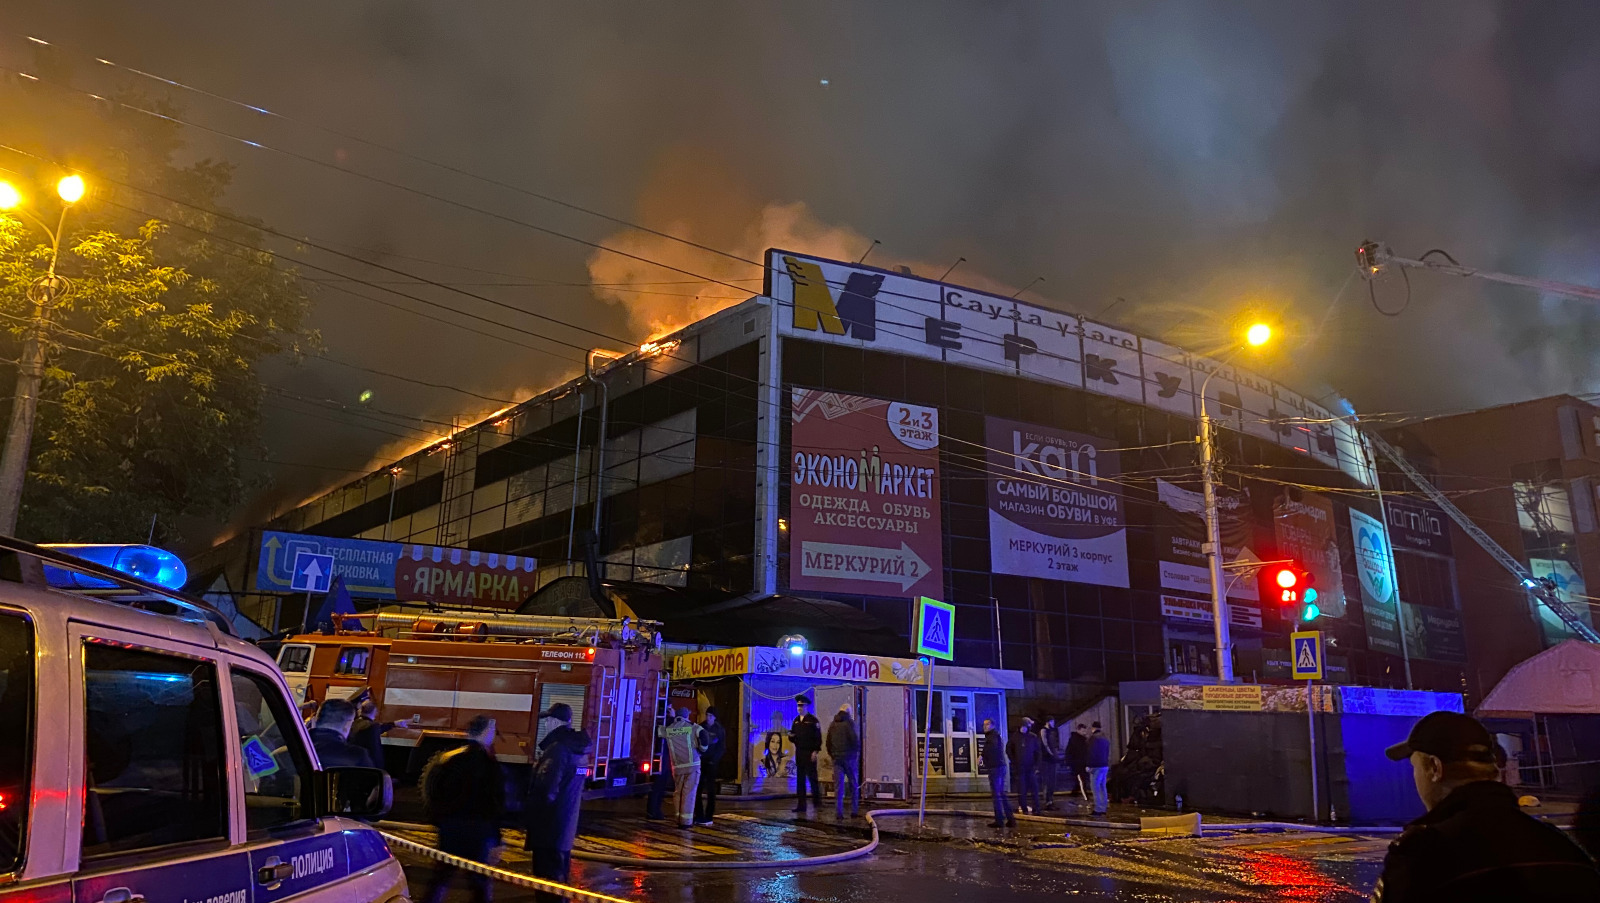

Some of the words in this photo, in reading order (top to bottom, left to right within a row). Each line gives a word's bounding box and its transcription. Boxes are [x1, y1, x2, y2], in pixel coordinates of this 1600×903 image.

[946, 291, 1042, 327] Сауза
[899, 428, 933, 441] этаж
[1025, 432, 1044, 443] ЕСЛИ
[1068, 440, 1078, 448] ТО
[1013, 430, 1098, 486] kari
[799, 493, 870, 513] ОДЕЖДА
[882, 502, 931, 519] ОБУВЬ
[996, 479, 1050, 502] САМЫЙ
[1052, 489, 1118, 512] БОЛЬШОЙ
[813, 511, 919, 534] АКСЕССУАРЫ
[1000, 500, 1045, 515] МАГАЗИН
[1047, 504, 1092, 523] ОБУВИ
[1094, 515, 1100, 523] В
[1101, 516, 1118, 527] УФЕ
[1387, 500, 1442, 537] familia
[325, 546, 393, 565] БЕСПЛАТНАЯ
[804, 551, 905, 577] МЕРКУРИЙ
[910, 561, 919, 577] 2
[1009, 538, 1071, 557] МЕРКУРИЙ
[1072, 547, 1079, 558] 3
[1080, 550, 1113, 565] корпус
[331, 566, 380, 580] АРКОВКА
[1047, 558, 1053, 569] 2
[1056, 561, 1079, 573] этаж
[413, 566, 519, 602] ЯРМАРКА
[541, 650, 573, 659] ТЕЛЕФОН
[574, 651, 586, 660] 112
[691, 652, 744, 675] ШАУРМА
[803, 654, 880, 679] ШАУРМА
[291, 847, 334, 880] ПОЛИЦИЯ
